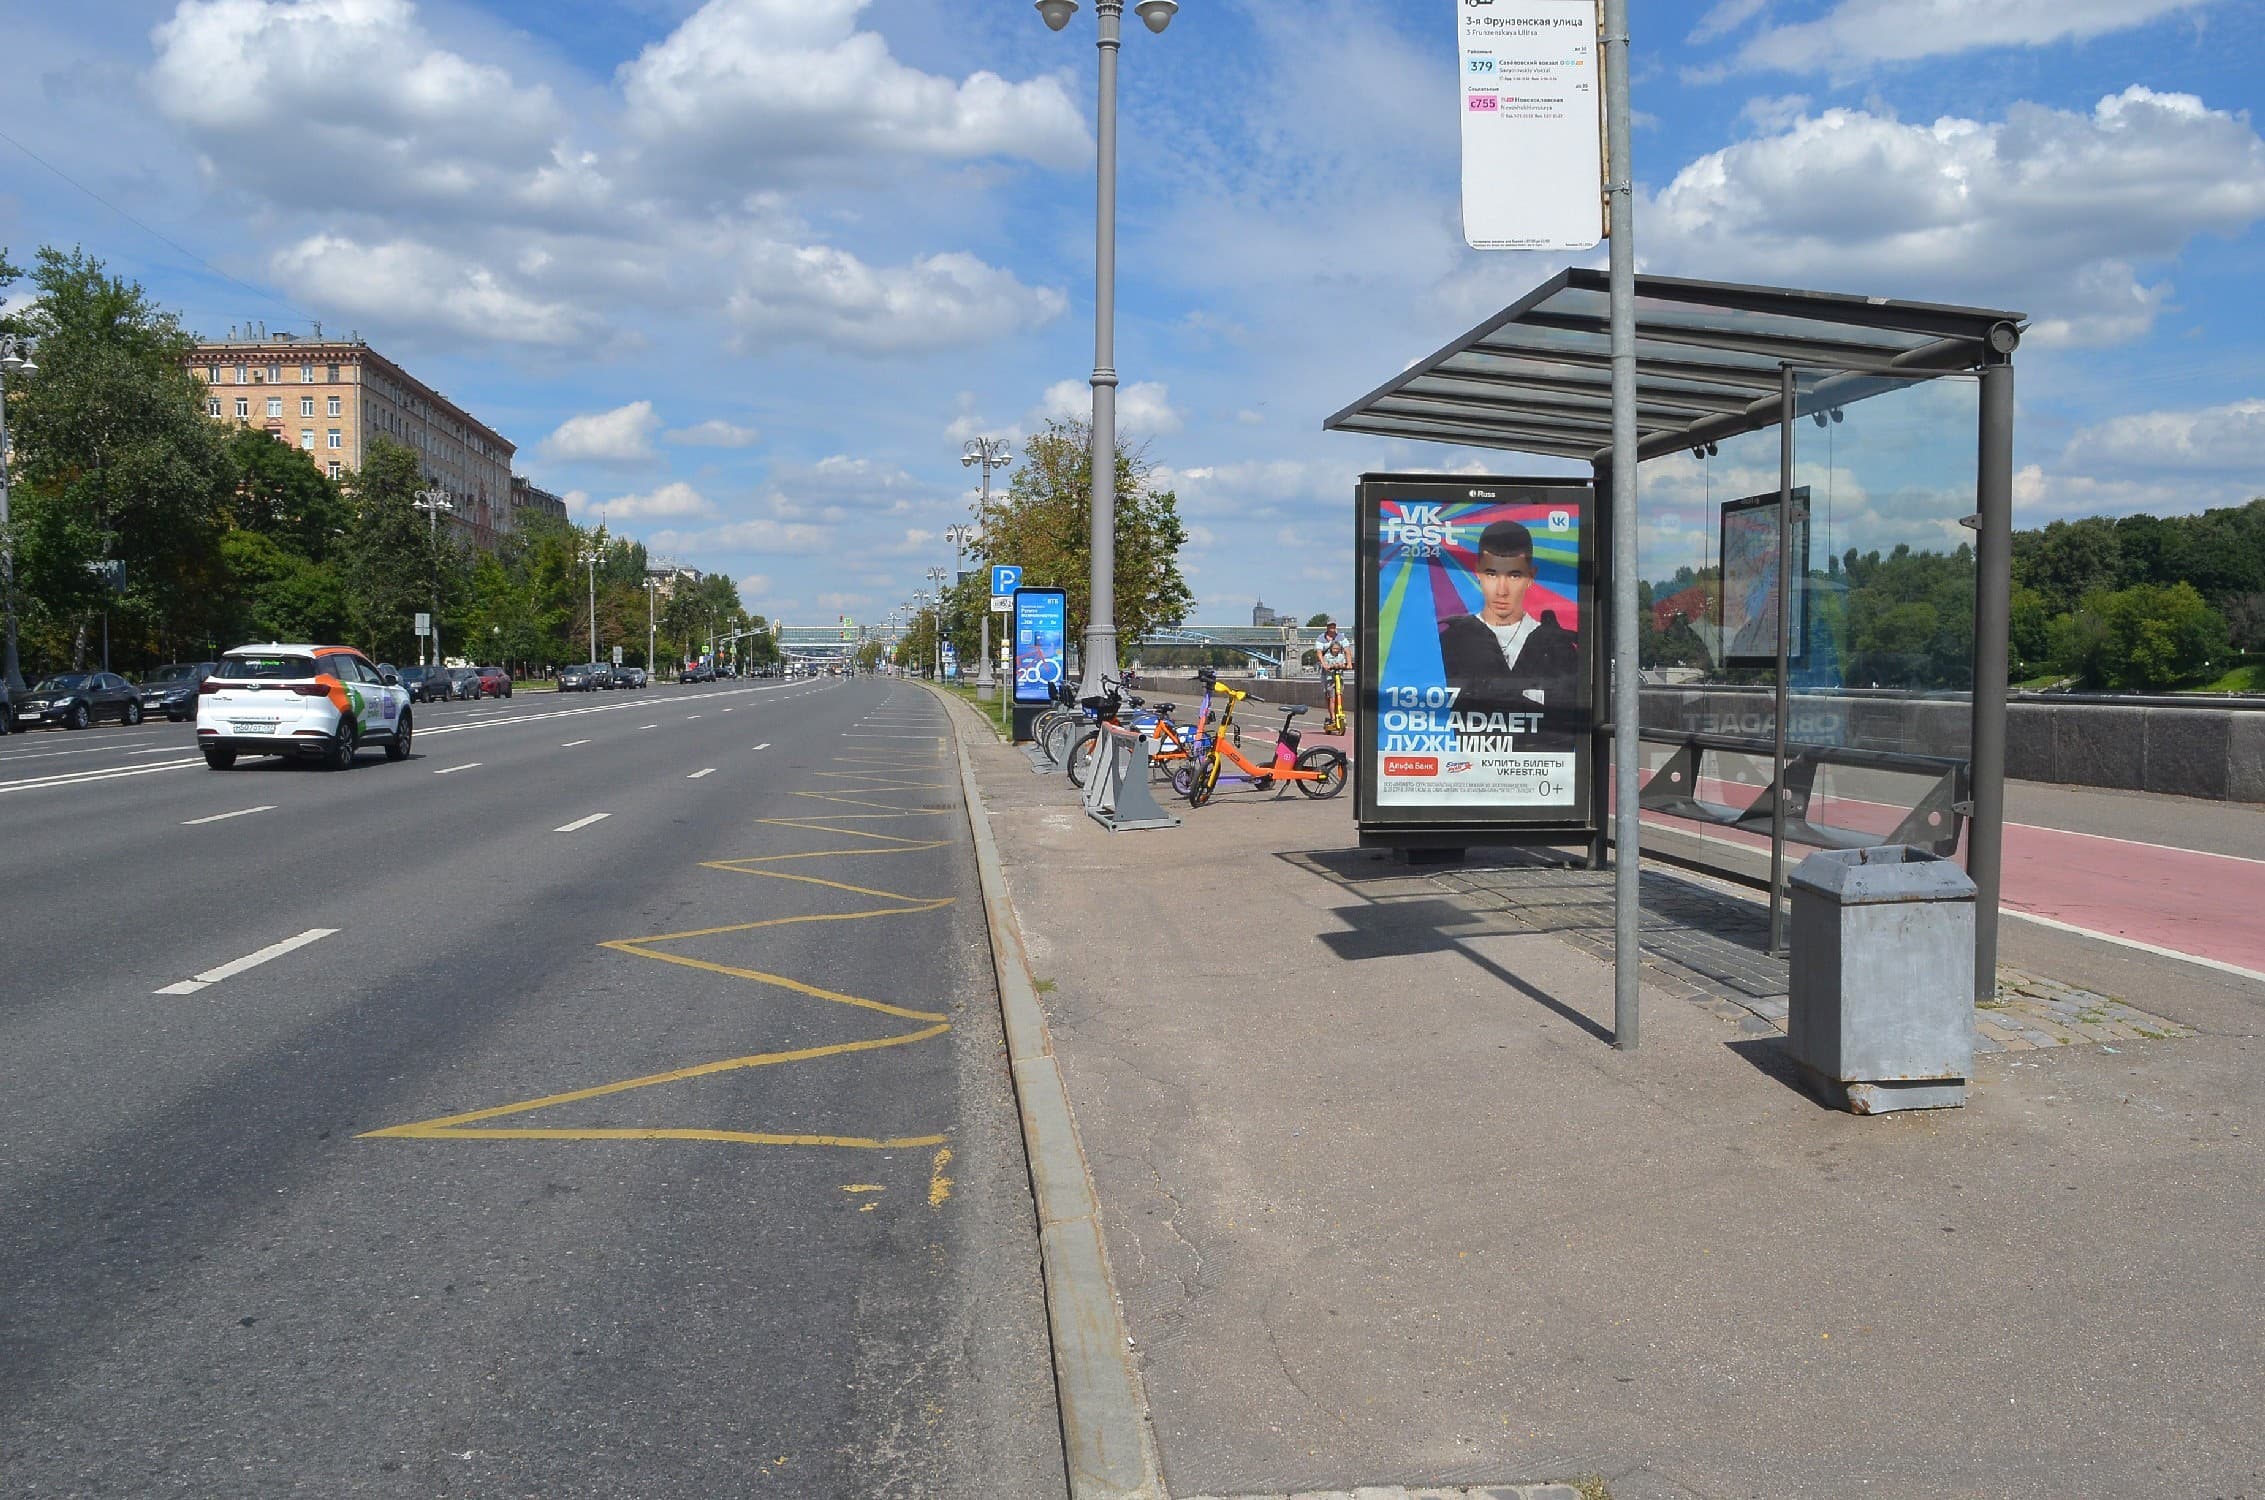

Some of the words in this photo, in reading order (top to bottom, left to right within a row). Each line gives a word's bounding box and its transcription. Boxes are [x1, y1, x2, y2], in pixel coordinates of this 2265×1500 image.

[1466, 17, 1481, 26] 3-я
[1484, 17, 1551, 28] Фрунзенская
[1553, 19, 1583, 28] улица
[1470, 61, 1493, 72] 379
[1477, 490, 1496, 499] Russ
[1400, 505, 1443, 525] VK
[1380, 518, 1466, 546] fest
[1400, 545, 1441, 558] 2024
[1000, 570, 1016, 592] P
[1385, 686, 1462, 708] 13.07
[1384, 711, 1545, 734] OBLADAET
[1384, 735, 1514, 753] ЛУЖНИКИ
[1388, 762, 1413, 772] Альфа
[1414, 762, 1435, 770] Банк
[1481, 759, 1521, 769] КУПИТЬ
[1523, 759, 1565, 769] БИЛЕТЫ
[1497, 768, 1549, 777] VKFEST.RU
[1538, 780, 1564, 797] 0+
